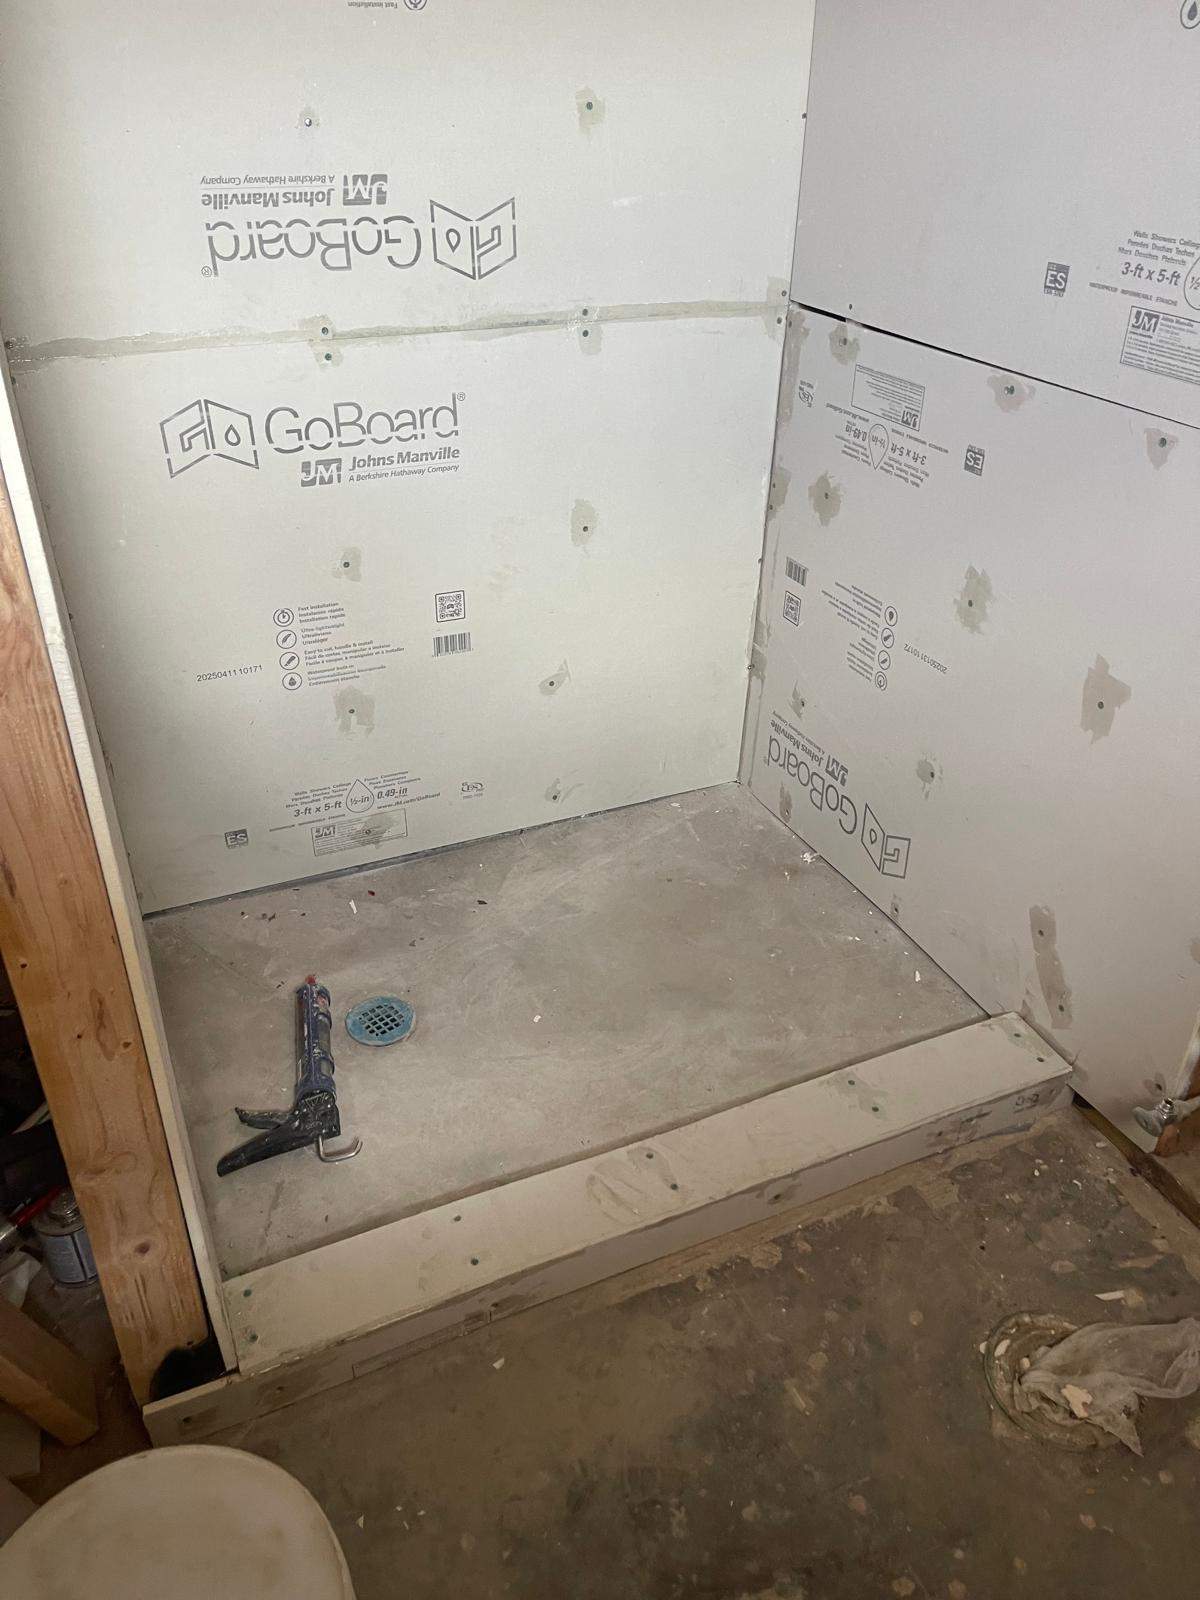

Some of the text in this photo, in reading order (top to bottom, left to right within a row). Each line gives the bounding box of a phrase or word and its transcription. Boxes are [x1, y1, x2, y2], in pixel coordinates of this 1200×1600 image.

[200, 175, 242, 186] Company
[243, 175, 287, 185] Hathaway
[288, 174, 326, 183] Berkshire
[200, 187, 335, 210] Johns Manville
[342, 173, 388, 207] JM
[1121, 261, 1145, 279] 3-ft
[1145, 269, 1156, 281] x
[1156, 268, 1181, 286] 5-ft
[1131, 309, 1160, 333] JM
[349, 446, 460, 471] Johns Manville
[890, 442, 905, 457] 5-ft
[911, 451, 927, 466] 3-ft
[301, 457, 343, 487] JM
[348, 464, 460, 482] A Berkshire Hathaway Company
[196, 664, 263, 682] 2025041110171
[770, 719, 801, 751] Manville
[801, 743, 825, 767] Johns
[376, 786, 408, 800] 0.49-in
[293, 806, 312, 818] 3-ft
[314, 806, 322, 814] x
[324, 800, 342, 811] 5-ft
